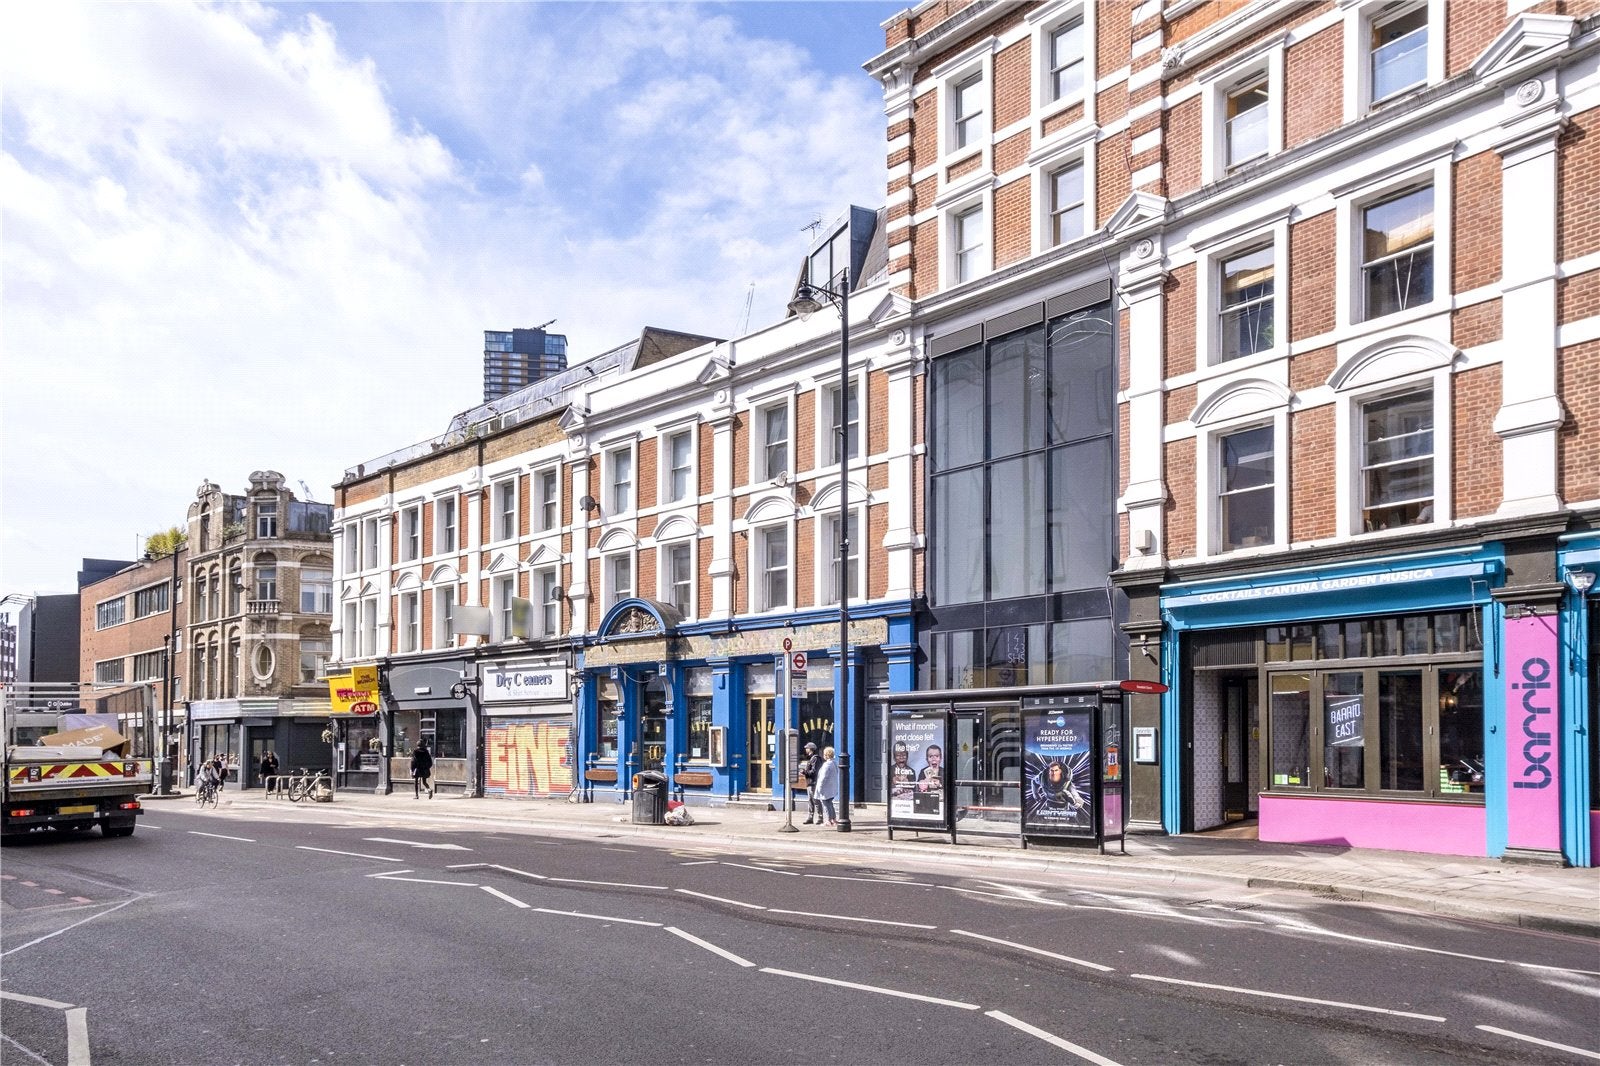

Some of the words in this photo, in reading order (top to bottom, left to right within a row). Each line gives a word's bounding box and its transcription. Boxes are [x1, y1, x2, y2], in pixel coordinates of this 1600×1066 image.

[1200, 588, 1261, 602] COCKTAILS
[1264, 582, 1318, 596] CANTINA
[1322, 575, 1376, 589] GARDEN
[1379, 568, 1434, 582] MUSICA
[496, 674, 512, 690] Dry
[354, 704, 375, 712] ATM
[1330, 703, 1361, 724] BARRIO
[1335, 720, 1356, 738] EAST
[1511, 657, 1552, 789] barrio
